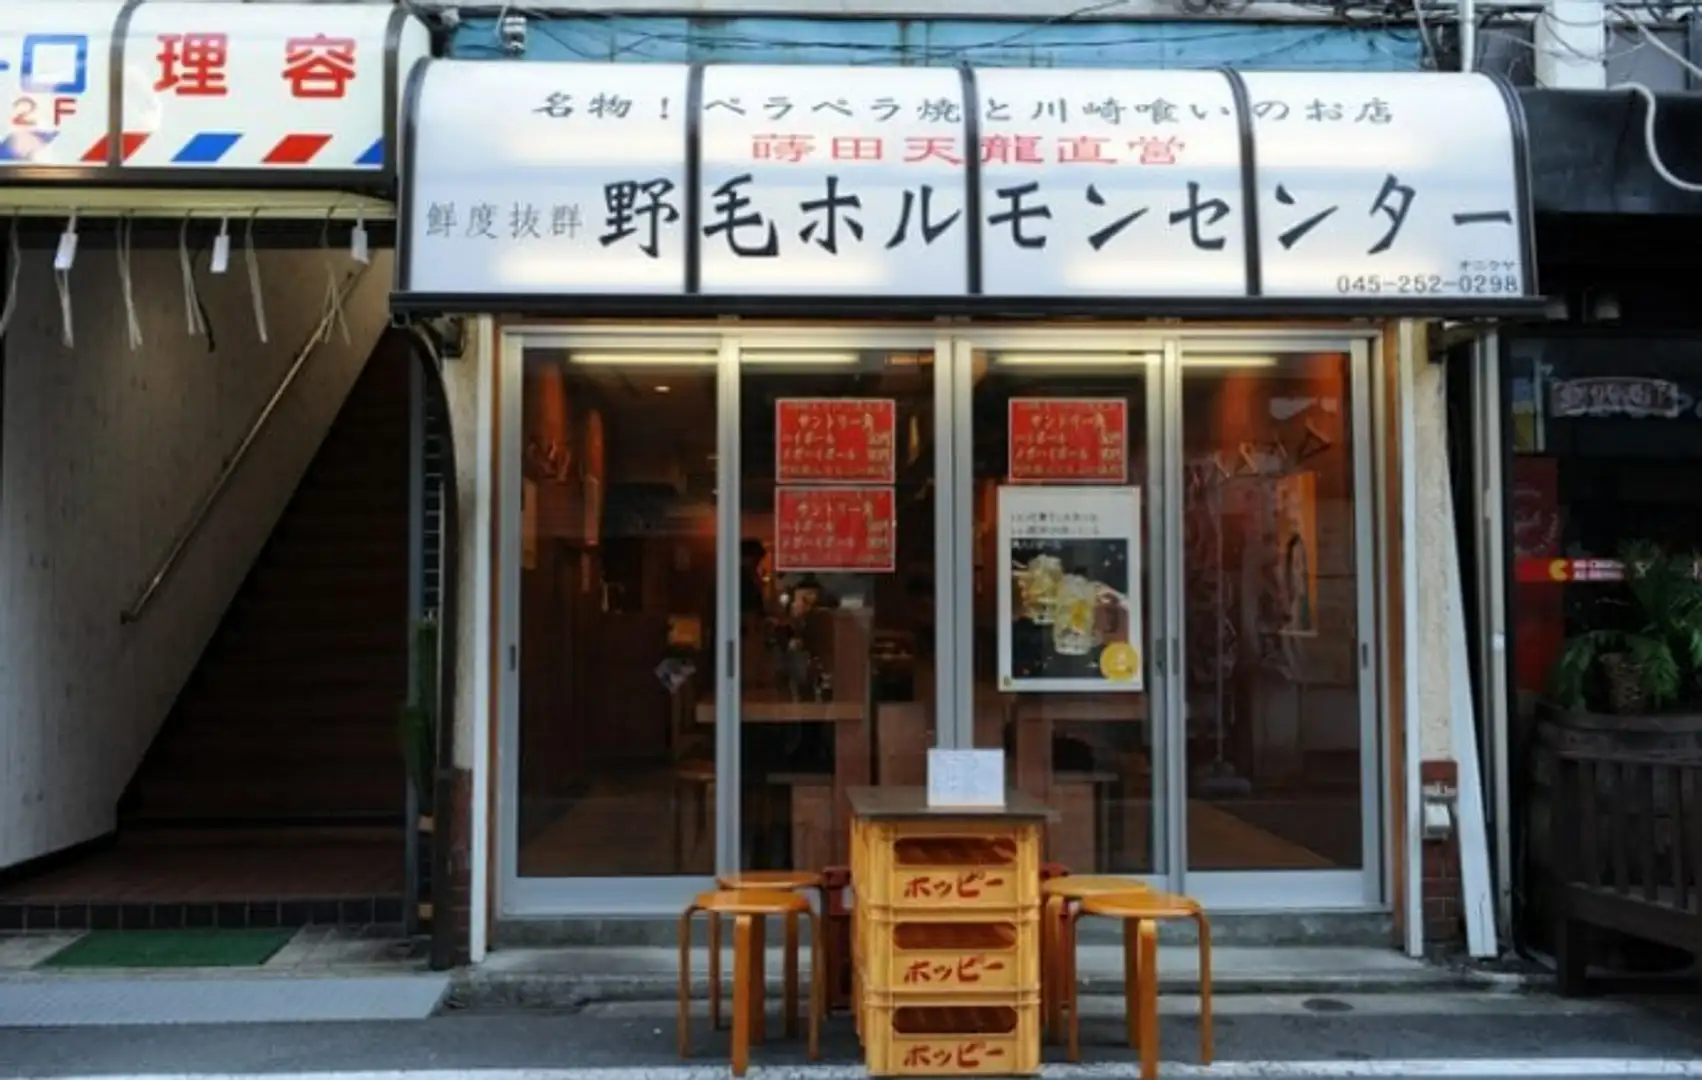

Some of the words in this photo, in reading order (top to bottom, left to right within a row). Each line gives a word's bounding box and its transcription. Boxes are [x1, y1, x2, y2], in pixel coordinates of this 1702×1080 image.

[154, 33, 356, 98] 理容
[12, 97, 77, 126] 2F
[425, 200, 583, 240] 鮮度抜群
[597, 173, 1513, 259] 野毛ホルモンセンター
[1336, 274, 1518, 294] 045-252-0298
[903, 868, 1005, 898] ホッピー
[903, 954, 1005, 983] ホッピー
[903, 1040, 1005, 1069] ホッピー
